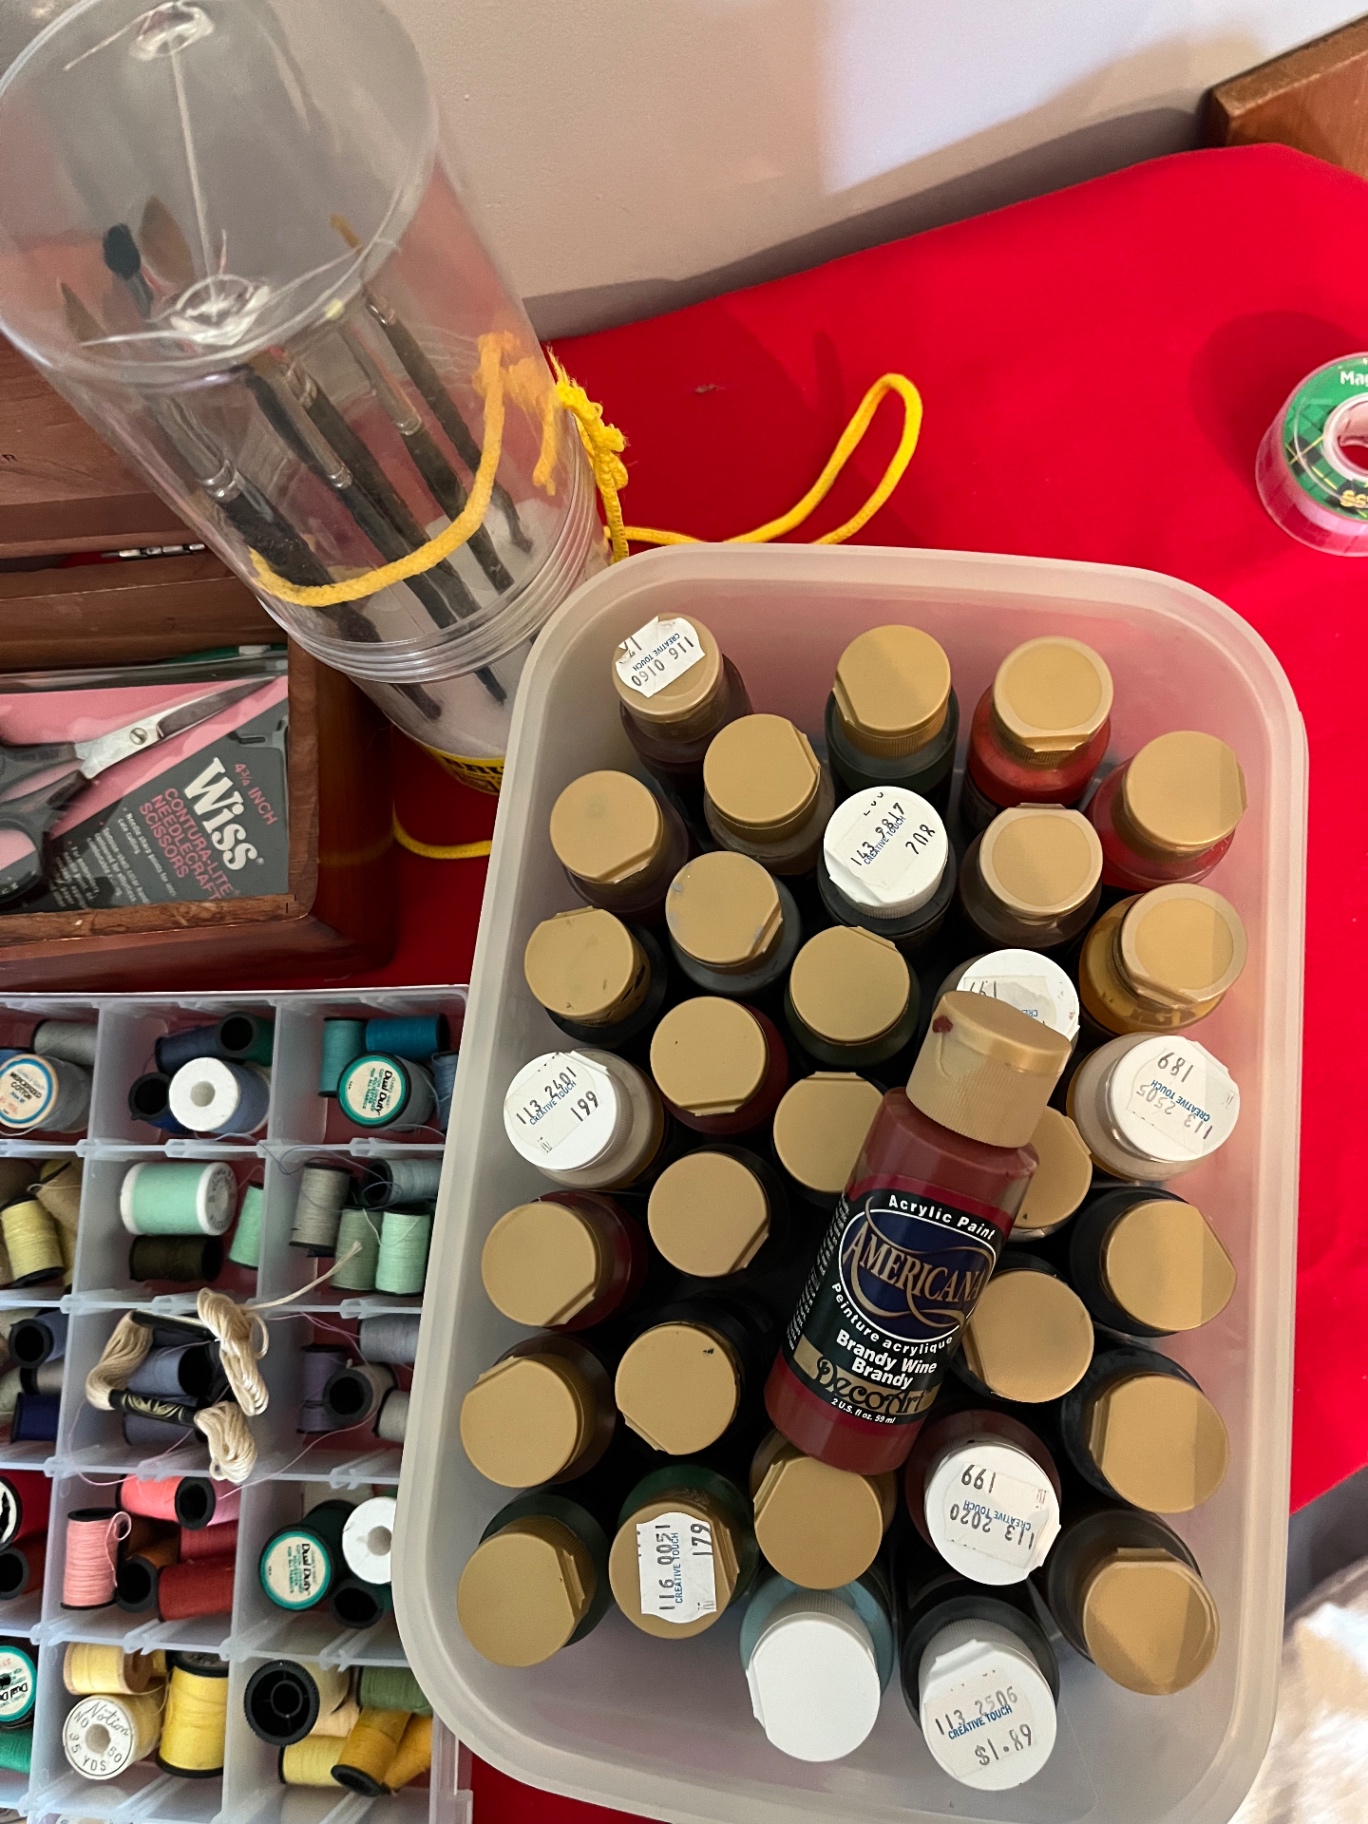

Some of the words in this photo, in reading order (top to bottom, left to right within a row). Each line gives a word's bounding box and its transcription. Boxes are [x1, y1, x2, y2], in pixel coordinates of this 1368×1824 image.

[653, 633, 680, 656] CREATIVE
[668, 636, 694, 660] 116
[631, 659, 665, 687] 0160
[632, 654, 654, 671] TOUCH
[184, 757, 259, 870] Wiss
[247, 787, 278, 825] INCH
[875, 802, 905, 838] 9817
[140, 802, 189, 878] SCISSORS
[151, 794, 222, 900] NEEDLECRAFT
[164, 787, 235, 897] CONTURA-LITE
[863, 838, 890, 865] CREATIVE
[886, 816, 906, 837] TOUCH
[382, 1070, 393, 1092] Dual
[1157, 1052, 1194, 1082] 189
[374, 1092, 388, 1116] Duty
[516, 1099, 542, 1125] 113
[544, 1066, 577, 1098] 2401
[529, 1098, 557, 1125] CREATIVE
[556, 1080, 577, 1099] TOUCH
[1136, 1084, 1176, 1115] 2505
[1150, 1079, 1176, 1099] TOUCH
[570, 1090, 599, 1122] 199
[1176, 1096, 1211, 1122] CREATIVE
[1184, 1113, 1213, 1140] 113
[888, 1194, 953, 1224] Acrylic
[957, 1217, 996, 1242] Paint
[831, 1282, 880, 1343] Peinture
[882, 1335, 954, 1357] acrylique
[836, 1329, 897, 1372] Brandy
[901, 1356, 938, 1375] Wine
[851, 1357, 914, 1390] Brandy
[838, 1398, 853, 1415] U.S.
[874, 1413, 886, 1424] 59
[885, 1415, 896, 1425] ml
[961, 1464, 996, 1493] 199
[950, 1504, 992, 1533] 2020
[963, 1500, 990, 1517] TOUCH
[993, 1510, 1031, 1531] CREATIVE
[655, 1524, 674, 1565] 0051
[671, 1532, 680, 1560] TOUCH
[690, 1523, 713, 1556] 179
[1004, 1524, 1034, 1550] 113
[302, 1544, 311, 1566] Dual
[658, 1579, 675, 1610] 116
[673, 1563, 683, 1604] CREATIVE
[74, 1711, 89, 1728] NO
[82, 1701, 129, 1736] Notion
[935, 1709, 965, 1735] 113
[974, 1686, 1018, 1716] 2506
[948, 1717, 986, 1740] CREATIVE
[985, 1704, 1013, 1723] TOUCH
[974, 1723, 1032, 1765] $1.89
[82, 1755, 107, 1772] YDS
